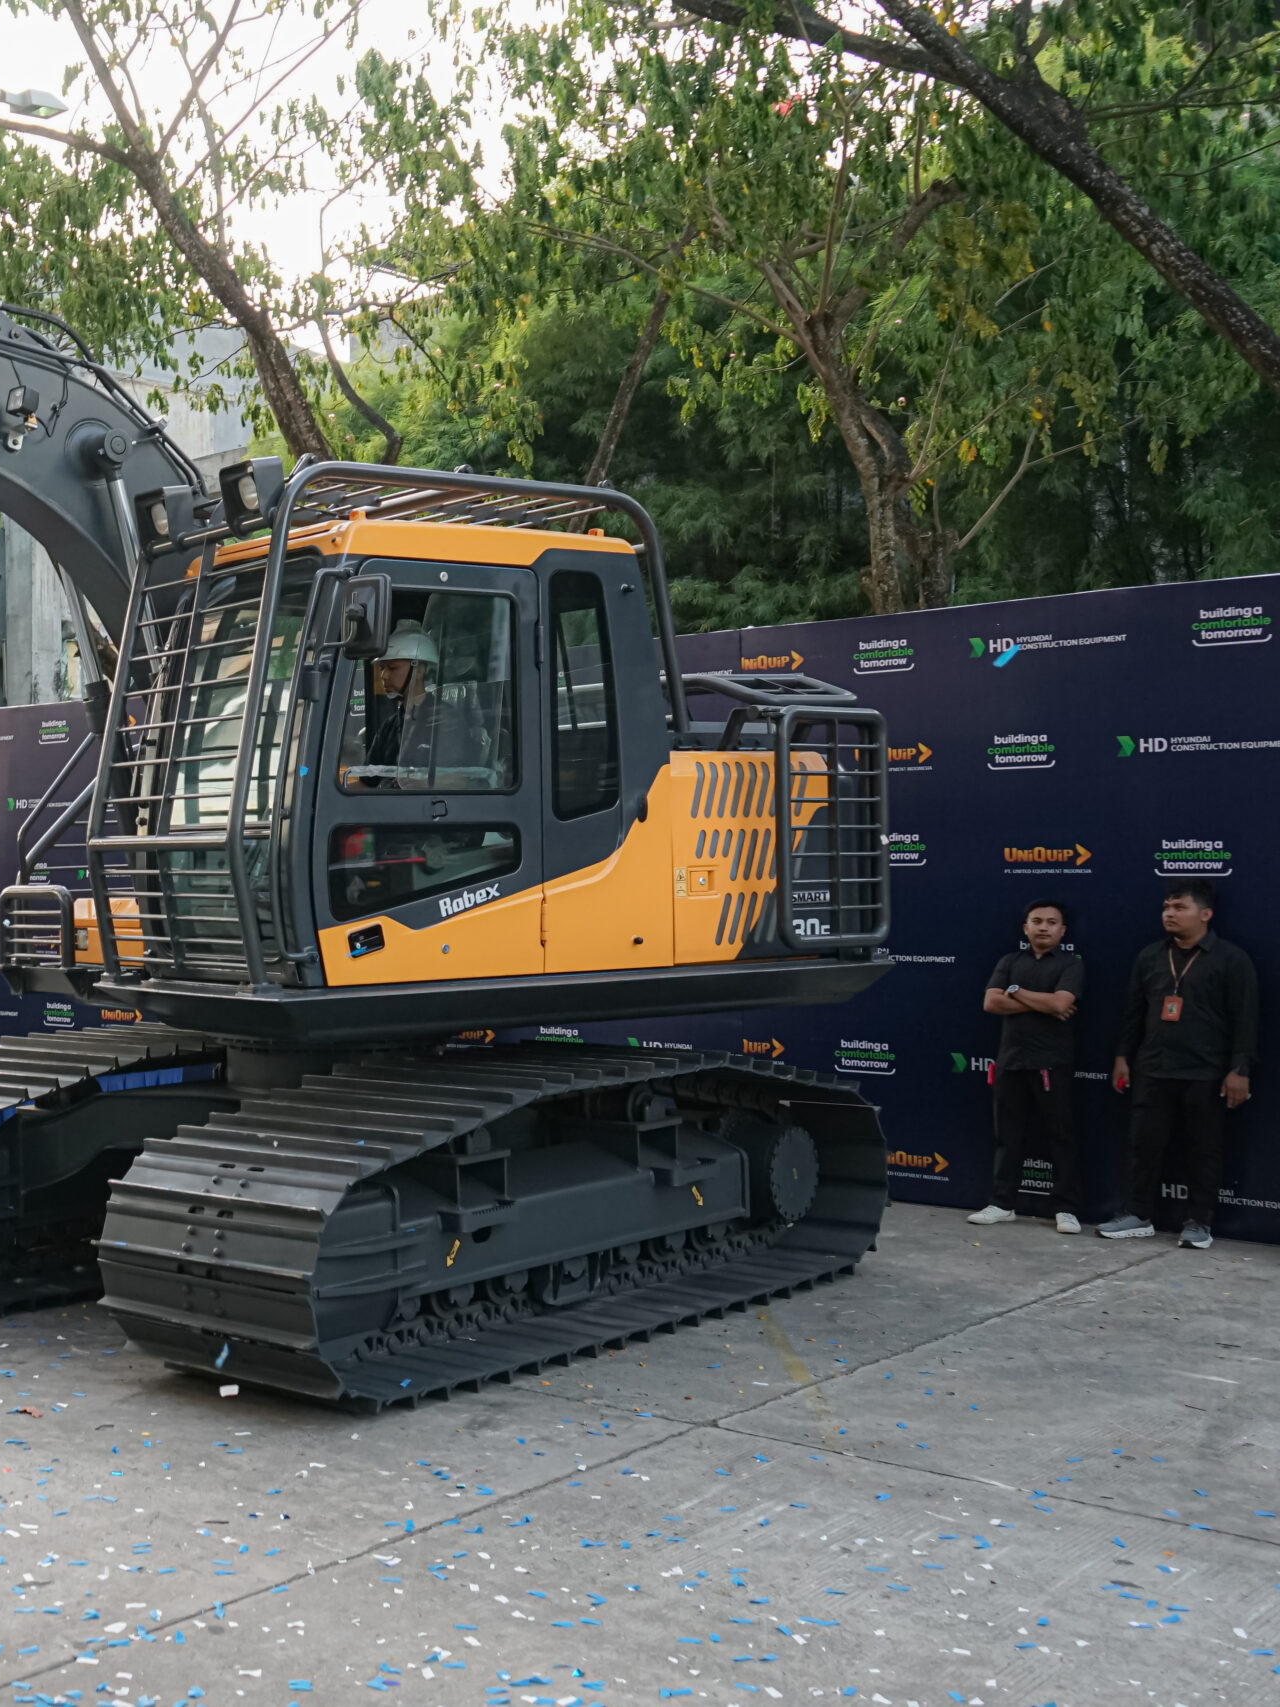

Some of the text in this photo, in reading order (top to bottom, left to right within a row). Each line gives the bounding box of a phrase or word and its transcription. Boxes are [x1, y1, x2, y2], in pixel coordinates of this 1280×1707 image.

[1199, 606, 1262, 619] building a
[1191, 616, 1272, 630] comfortable
[1016, 634, 1052, 644] HYUNDAI
[1201, 628, 1262, 640] tomorrow
[859, 639, 907, 650] building a
[989, 637, 1015, 653] HD
[1017, 634, 1127, 651] CONSTRUCTION EQUIPMENT
[853, 648, 914, 661] comfortable
[860, 656, 907, 669] tomorrow
[993, 734, 1048, 745] building a
[1139, 737, 1168, 753] HD
[1170, 736, 1211, 744] HYUNDAI
[987, 743, 1056, 755] comfortable
[1170, 742, 1240, 752] CONSTRUCTION
[995, 752, 1048, 763] tomorrow
[16, 799, 28, 809] HD
[911, 833, 920, 842] a
[1161, 839, 1223, 851] building a
[1154, 849, 1232, 861] comfortable
[1163, 859, 1223, 870] tomorrow
[438, 882, 501, 918] Robex
[791, 890, 829, 903] SMART
[913, 954, 956, 963] EQUIPMENT
[540, 1025, 579, 1038] building a
[664, 1042, 693, 1051] HYUNDAI
[840, 1039, 889, 1052] building a
[834, 1049, 896, 1061] comfortable
[841, 1057, 889, 1069] tomorrow
[1161, 1183, 1189, 1200] HD
